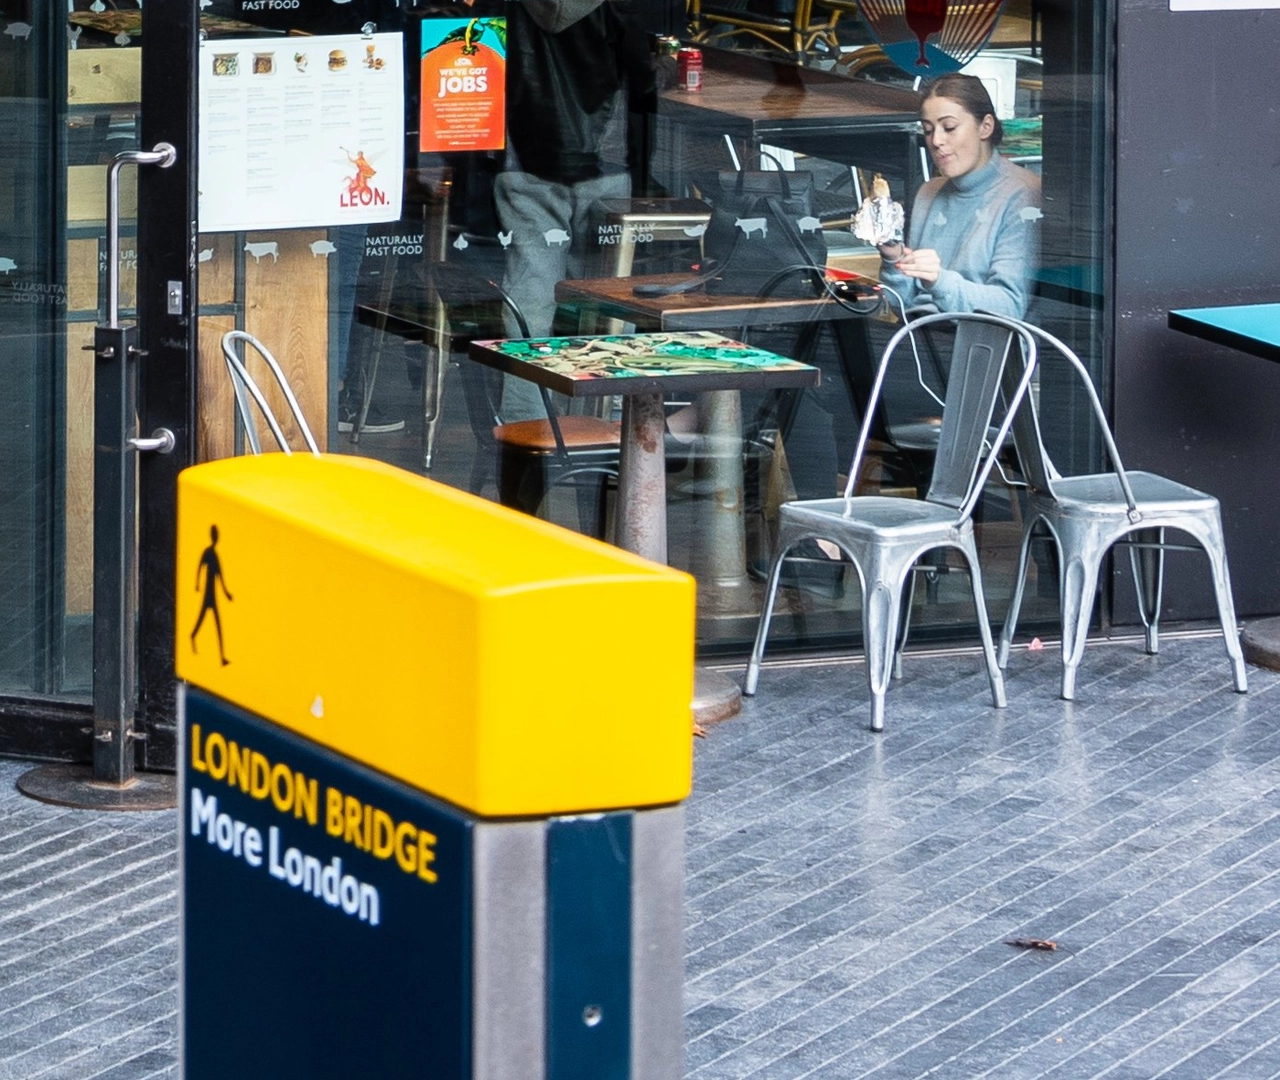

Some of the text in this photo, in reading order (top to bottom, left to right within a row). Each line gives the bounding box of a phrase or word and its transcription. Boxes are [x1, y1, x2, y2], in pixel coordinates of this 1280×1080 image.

[242, 0, 300, 10] FAST FOOD
[468, 66, 488, 76] GOT
[437, 75, 488, 98] JOBS
[365, 234, 424, 246] NATURALLY
[365, 245, 423, 257] FAST FOOD
[191, 723, 438, 884] LONDON BRIDGE
[191, 786, 380, 927] More London
